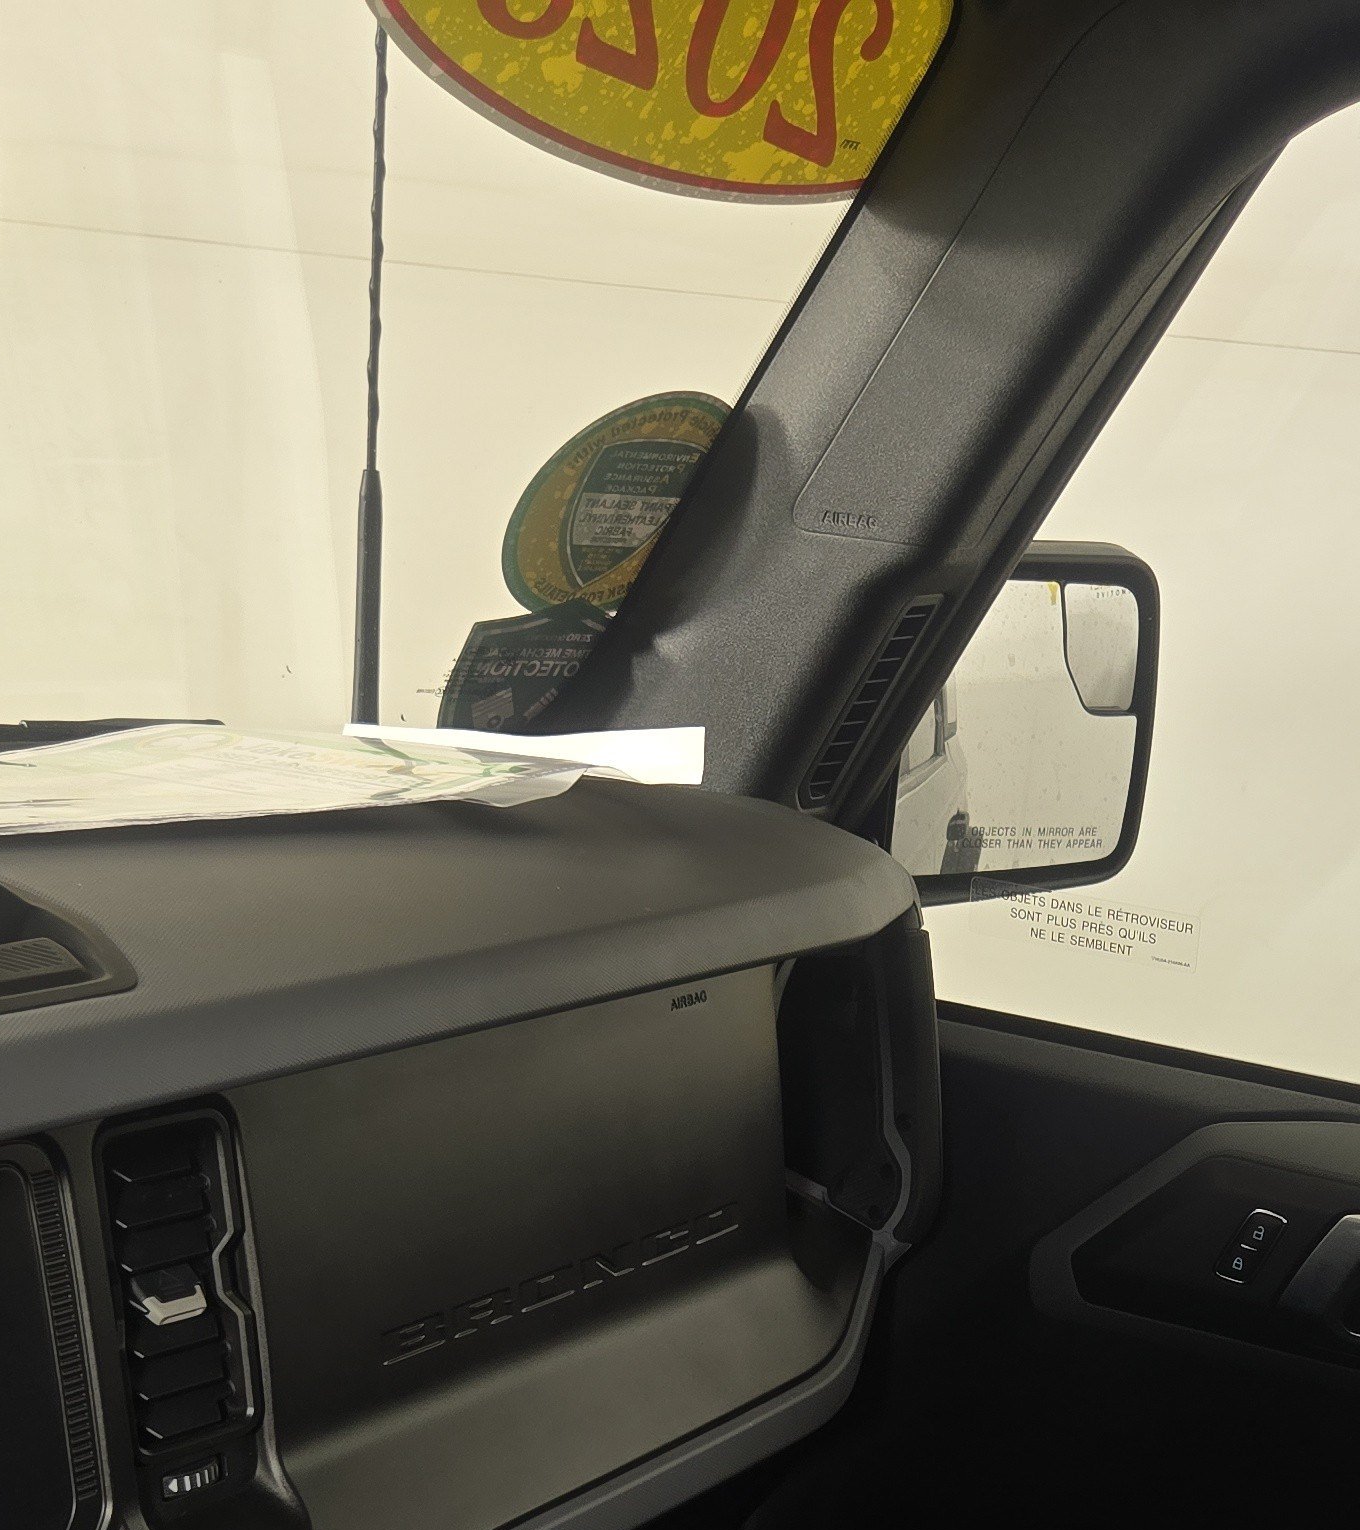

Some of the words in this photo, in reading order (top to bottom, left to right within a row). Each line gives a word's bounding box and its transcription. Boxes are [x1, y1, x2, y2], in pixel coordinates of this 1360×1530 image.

[821, 510, 879, 529] AIRBAG
[971, 826, 1016, 837] OBJECTS
[1021, 826, 1032, 837] IN
[1038, 827, 1074, 837] MIRROR
[1078, 827, 1098, 837] ARE
[962, 838, 1001, 849] CLOSER
[1007, 838, 1032, 849] THAN
[1038, 838, 1062, 849] THEY
[1066, 839, 1103, 849] APPEAR
[1001, 889, 1047, 908] OBJETS
[1050, 898, 1083, 915] DANS
[1088, 904, 1103, 918] LE
[1107, 906, 1194, 935] RÉTROVISEUR
[1010, 907, 1042, 923] SONT
[1046, 914, 1077, 930] PLUS
[1082, 919, 1114, 936] PRÈS
[1118, 927, 1157, 945] QU'ILS
[1030, 927, 1046, 941] NE
[1051, 930, 1065, 943] LE
[1070, 934, 1133, 956] SEMBLENT
[670, 989, 707, 1011] AIRBAG
